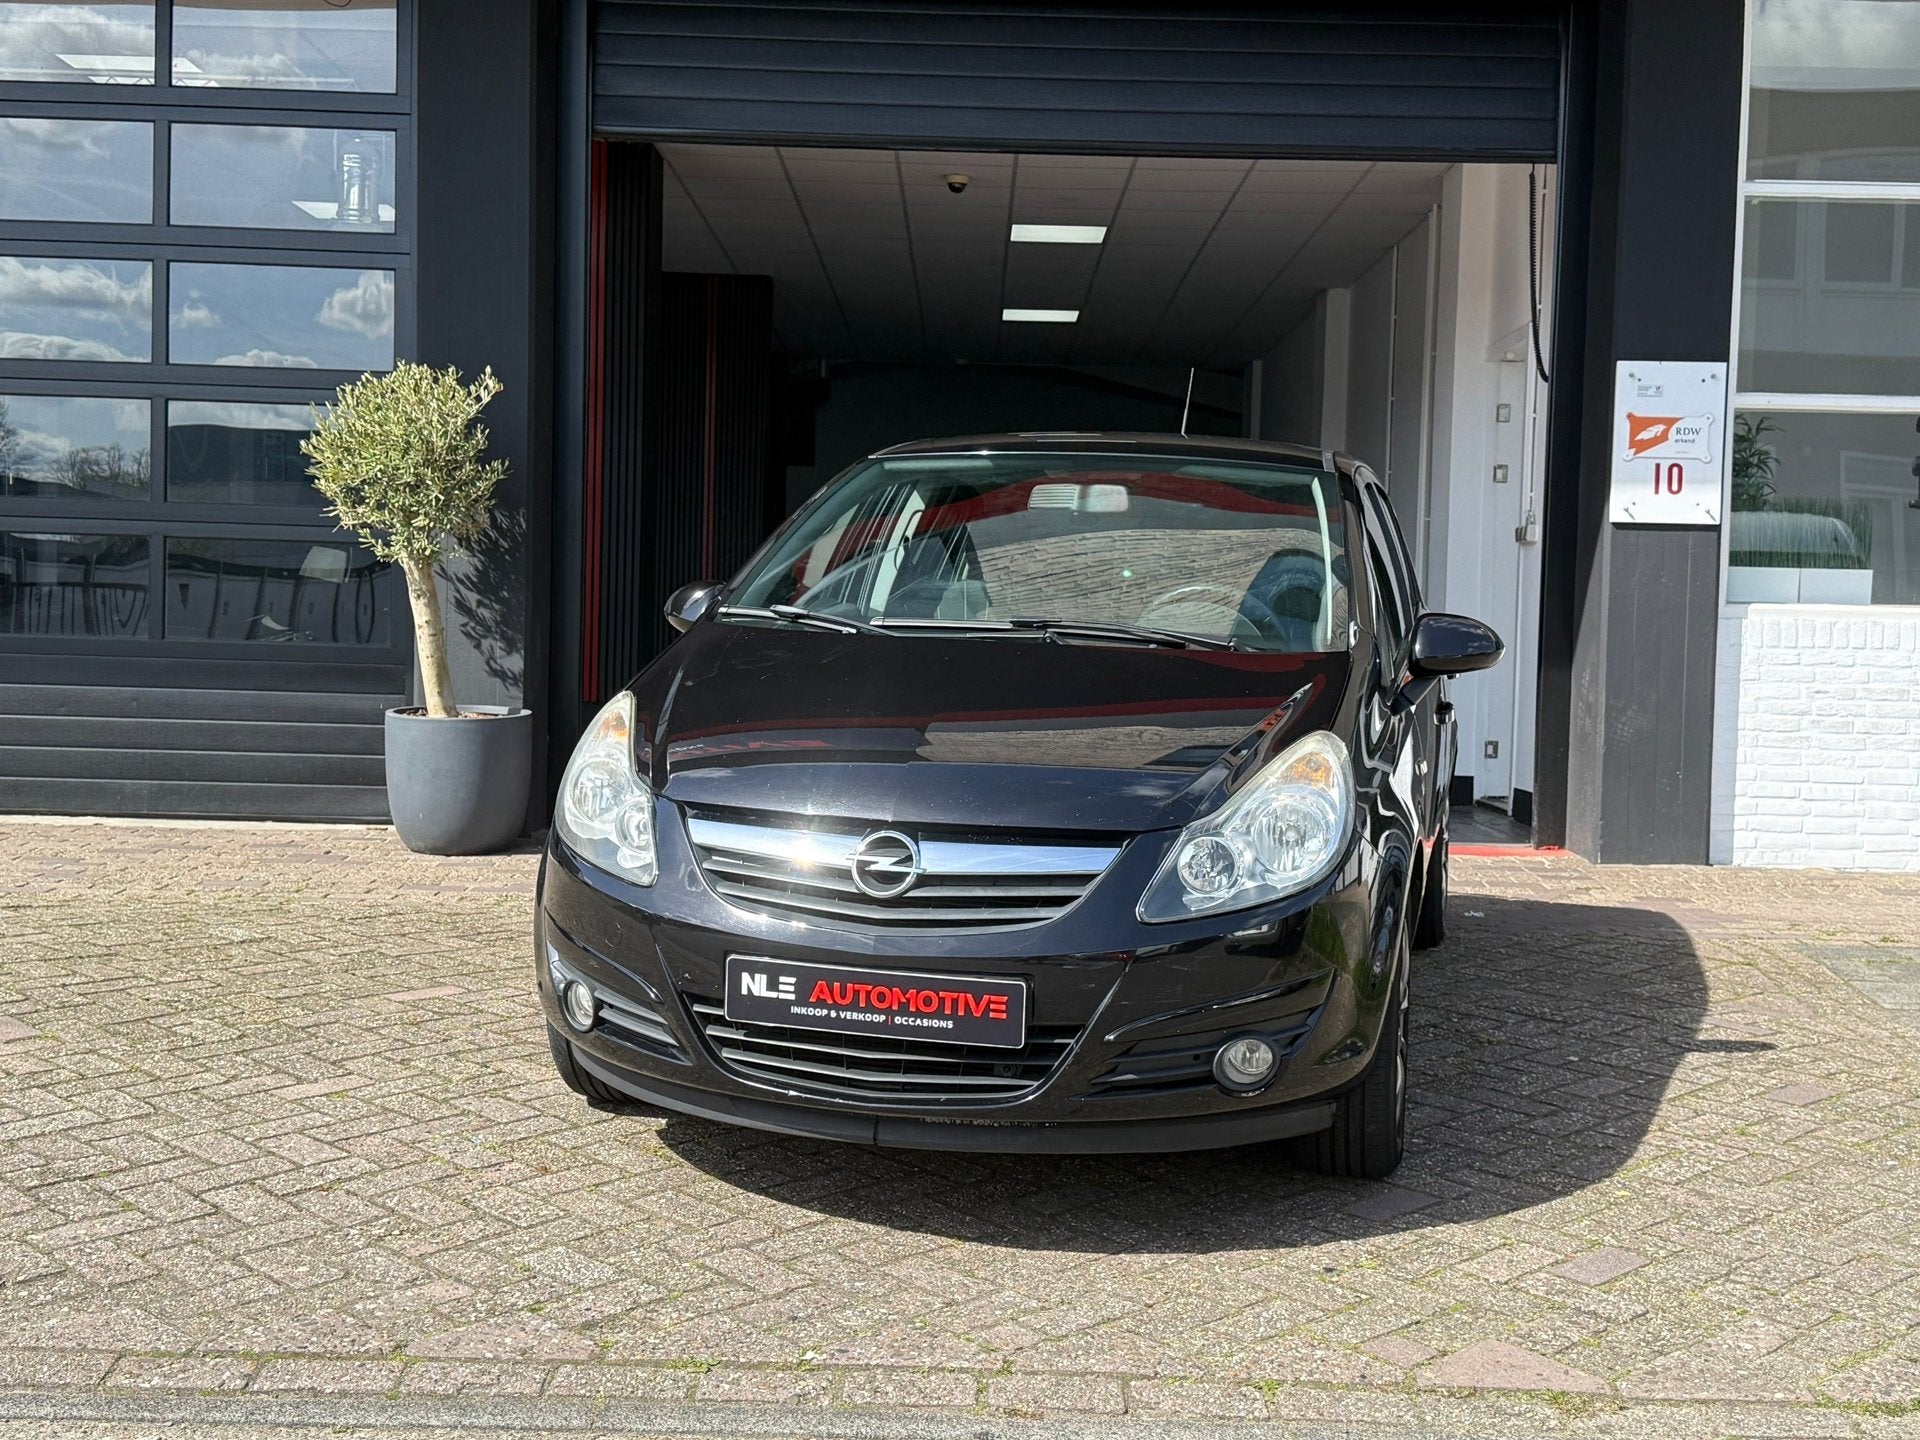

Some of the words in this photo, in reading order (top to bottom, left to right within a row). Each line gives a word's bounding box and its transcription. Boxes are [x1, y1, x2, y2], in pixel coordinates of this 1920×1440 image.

[1675, 426, 1702, 436] RDW
[1654, 462, 1684, 495] 10
[741, 971, 797, 1001] NLE
[808, 980, 1009, 1020] AUTOMOTIVE
[790, 1005, 828, 1018] INKOOP
[830, 1009, 837, 1018] &
[839, 1011, 886, 1023] VERKOOP
[894, 1015, 954, 1029] OCCASIONS
